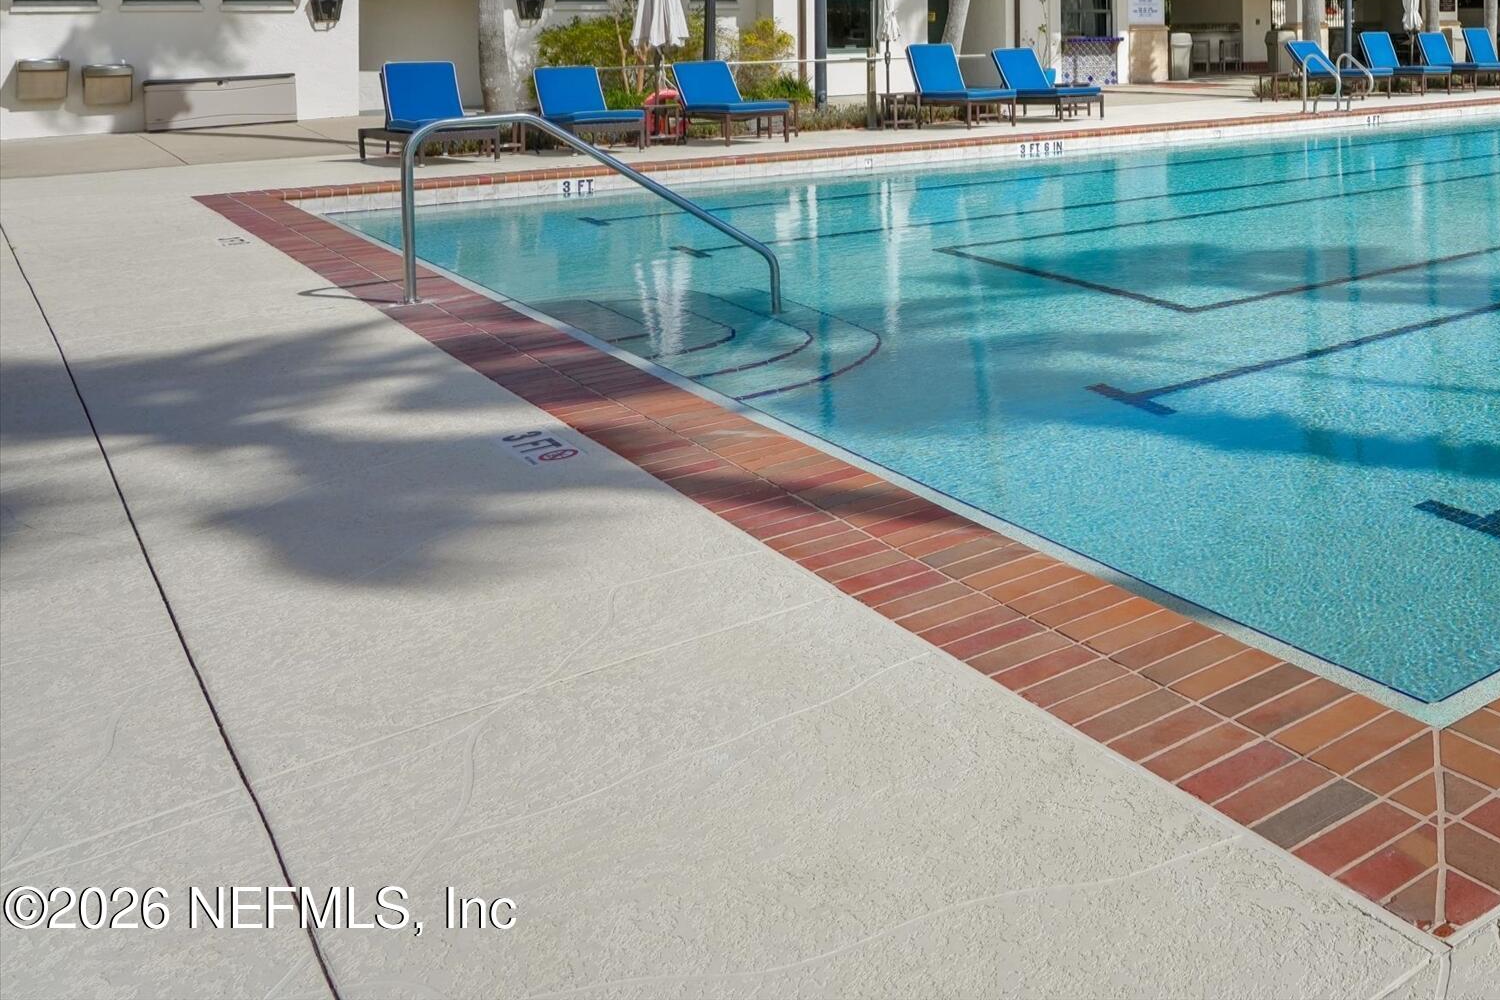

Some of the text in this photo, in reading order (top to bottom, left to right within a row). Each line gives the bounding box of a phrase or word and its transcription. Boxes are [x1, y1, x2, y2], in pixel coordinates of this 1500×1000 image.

[1020, 144, 1026, 154] 3
[1030, 143, 1040, 153] FT
[1053, 141, 1063, 151] IN
[562, 181, 570, 193] 3
[502, 431, 562, 453] 3 FT
